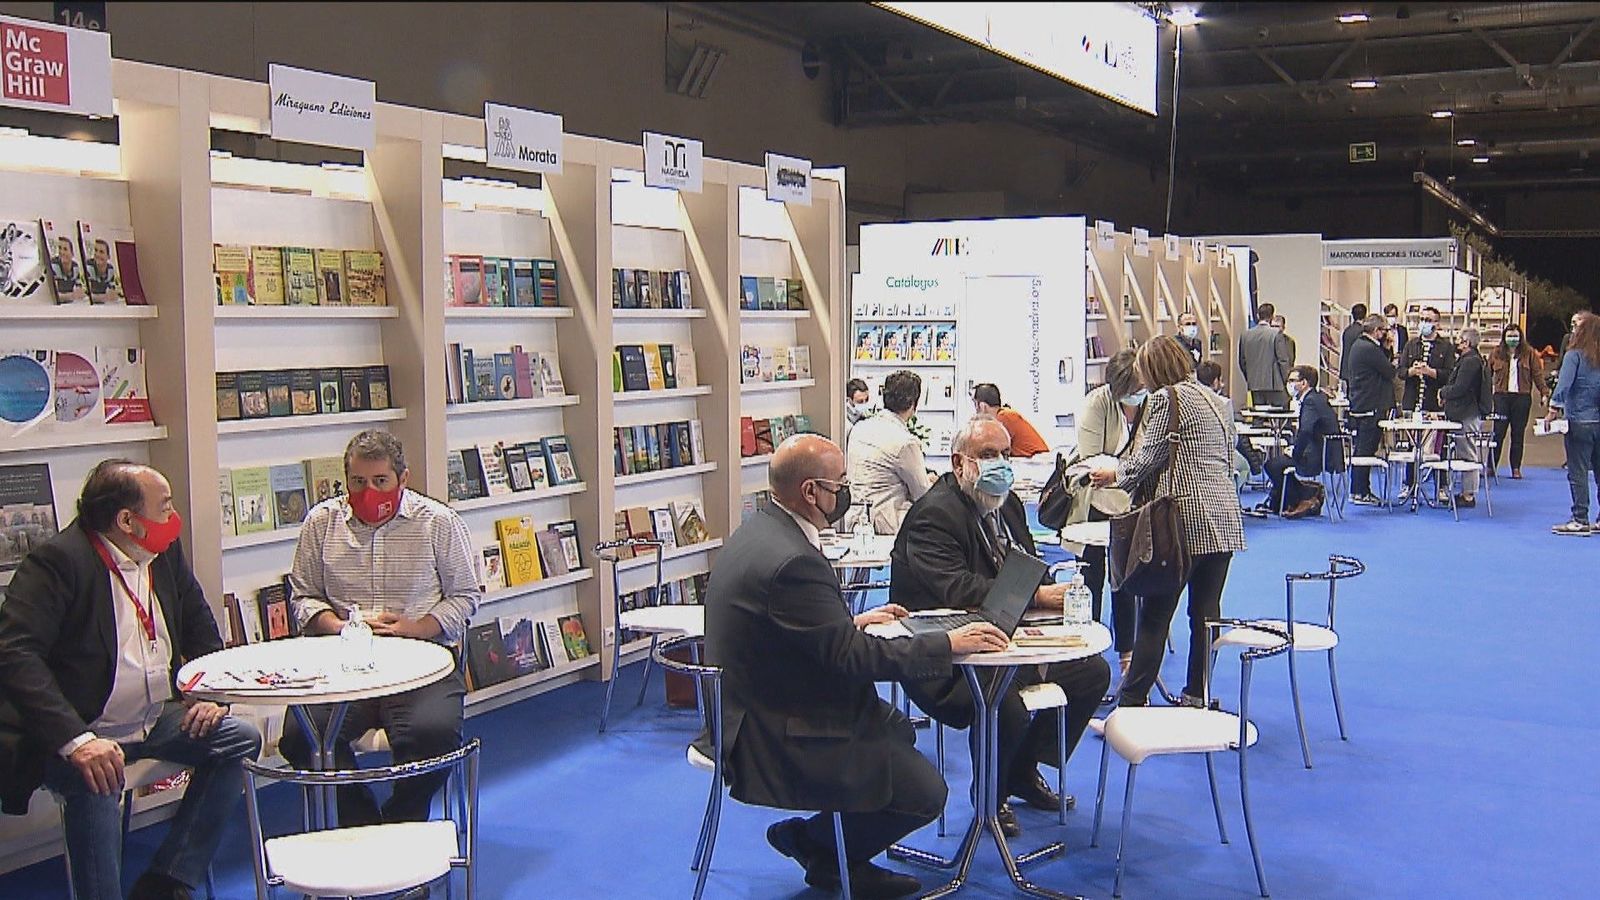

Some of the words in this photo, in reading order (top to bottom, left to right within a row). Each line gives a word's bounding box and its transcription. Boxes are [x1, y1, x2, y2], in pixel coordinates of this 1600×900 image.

[6, 28, 41, 53] Mc
[5, 51, 64, 78] Graw
[7, 73, 46, 98] Hill
[274, 92, 325, 115] Miraguano
[329, 101, 371, 120] Ediciones
[519, 145, 557, 165] Morata
